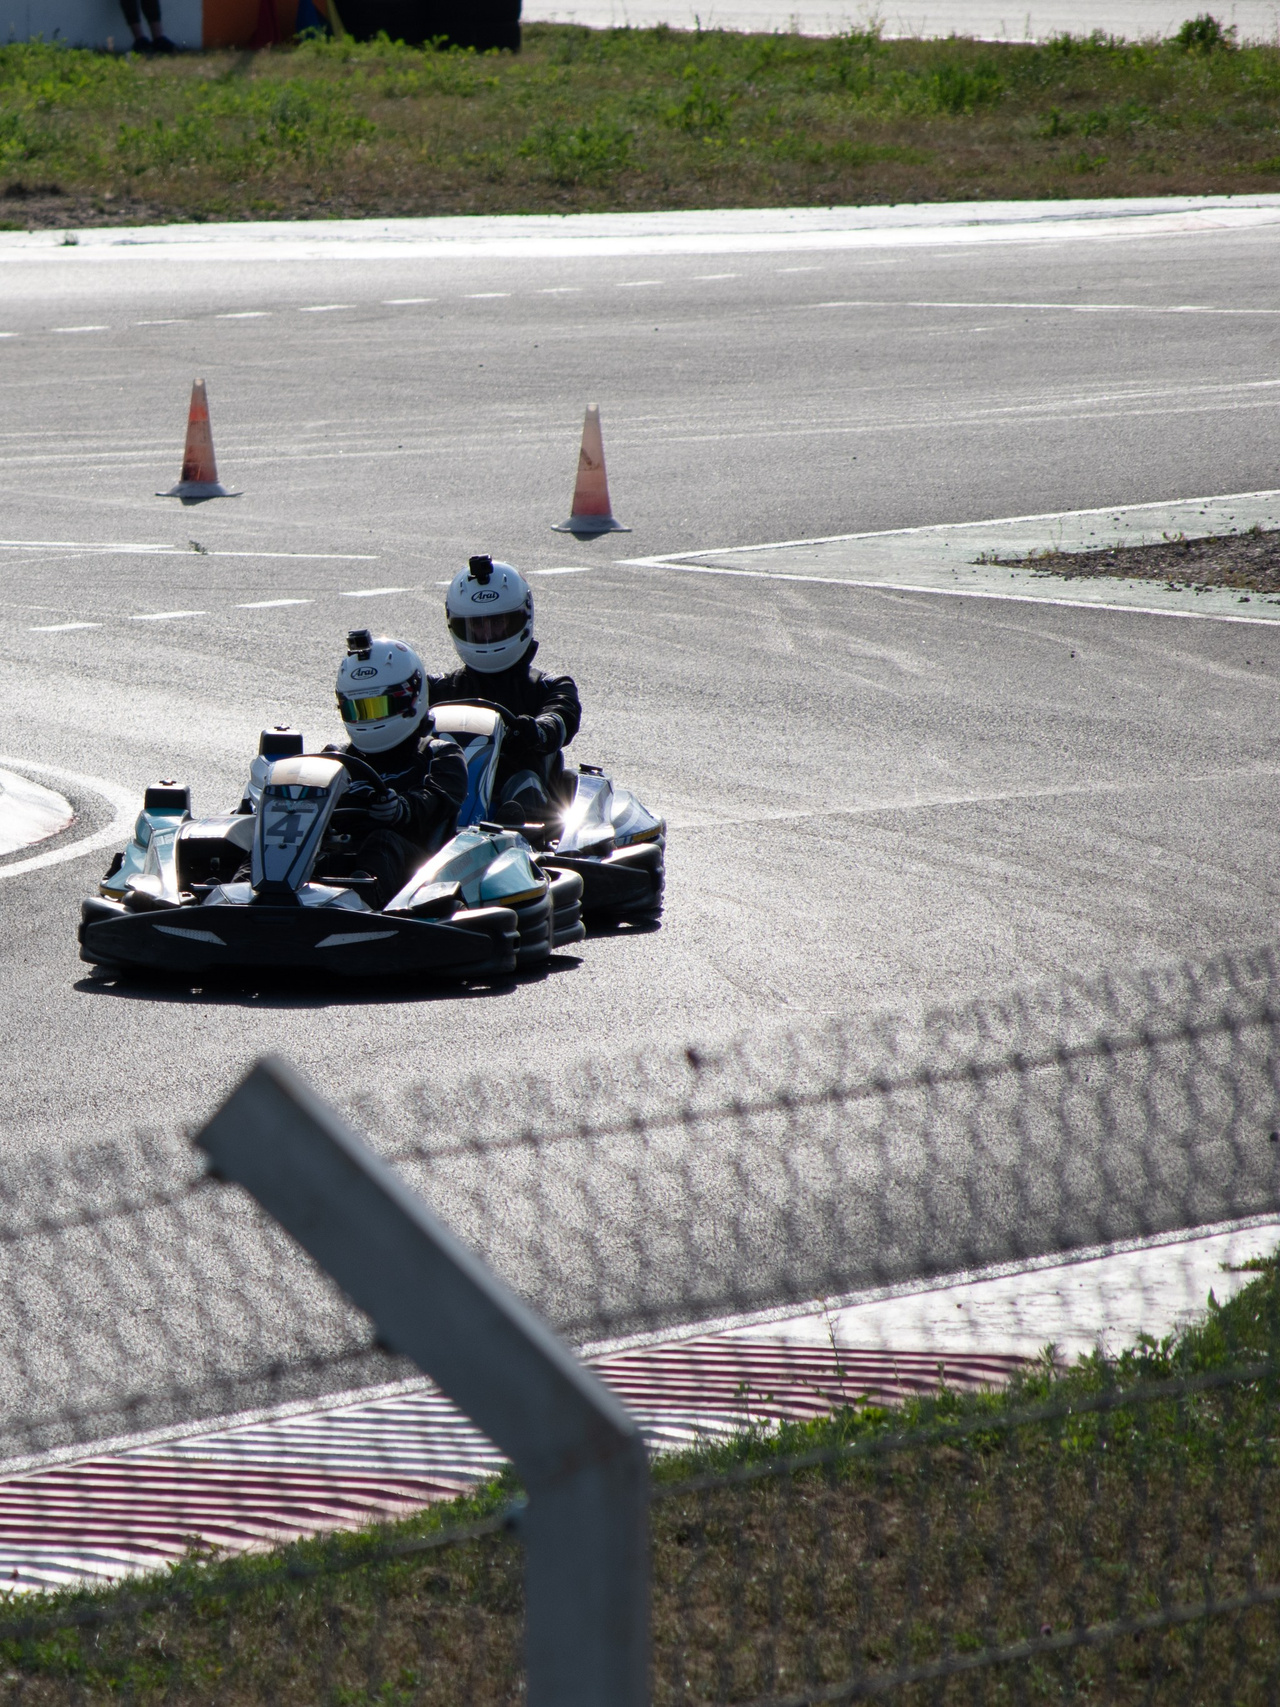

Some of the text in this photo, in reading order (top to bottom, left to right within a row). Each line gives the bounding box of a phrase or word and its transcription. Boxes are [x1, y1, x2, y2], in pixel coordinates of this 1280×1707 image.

[474, 591, 497, 601] Arai
[353, 667, 375, 677] Arai
[266, 814, 304, 843] 4
